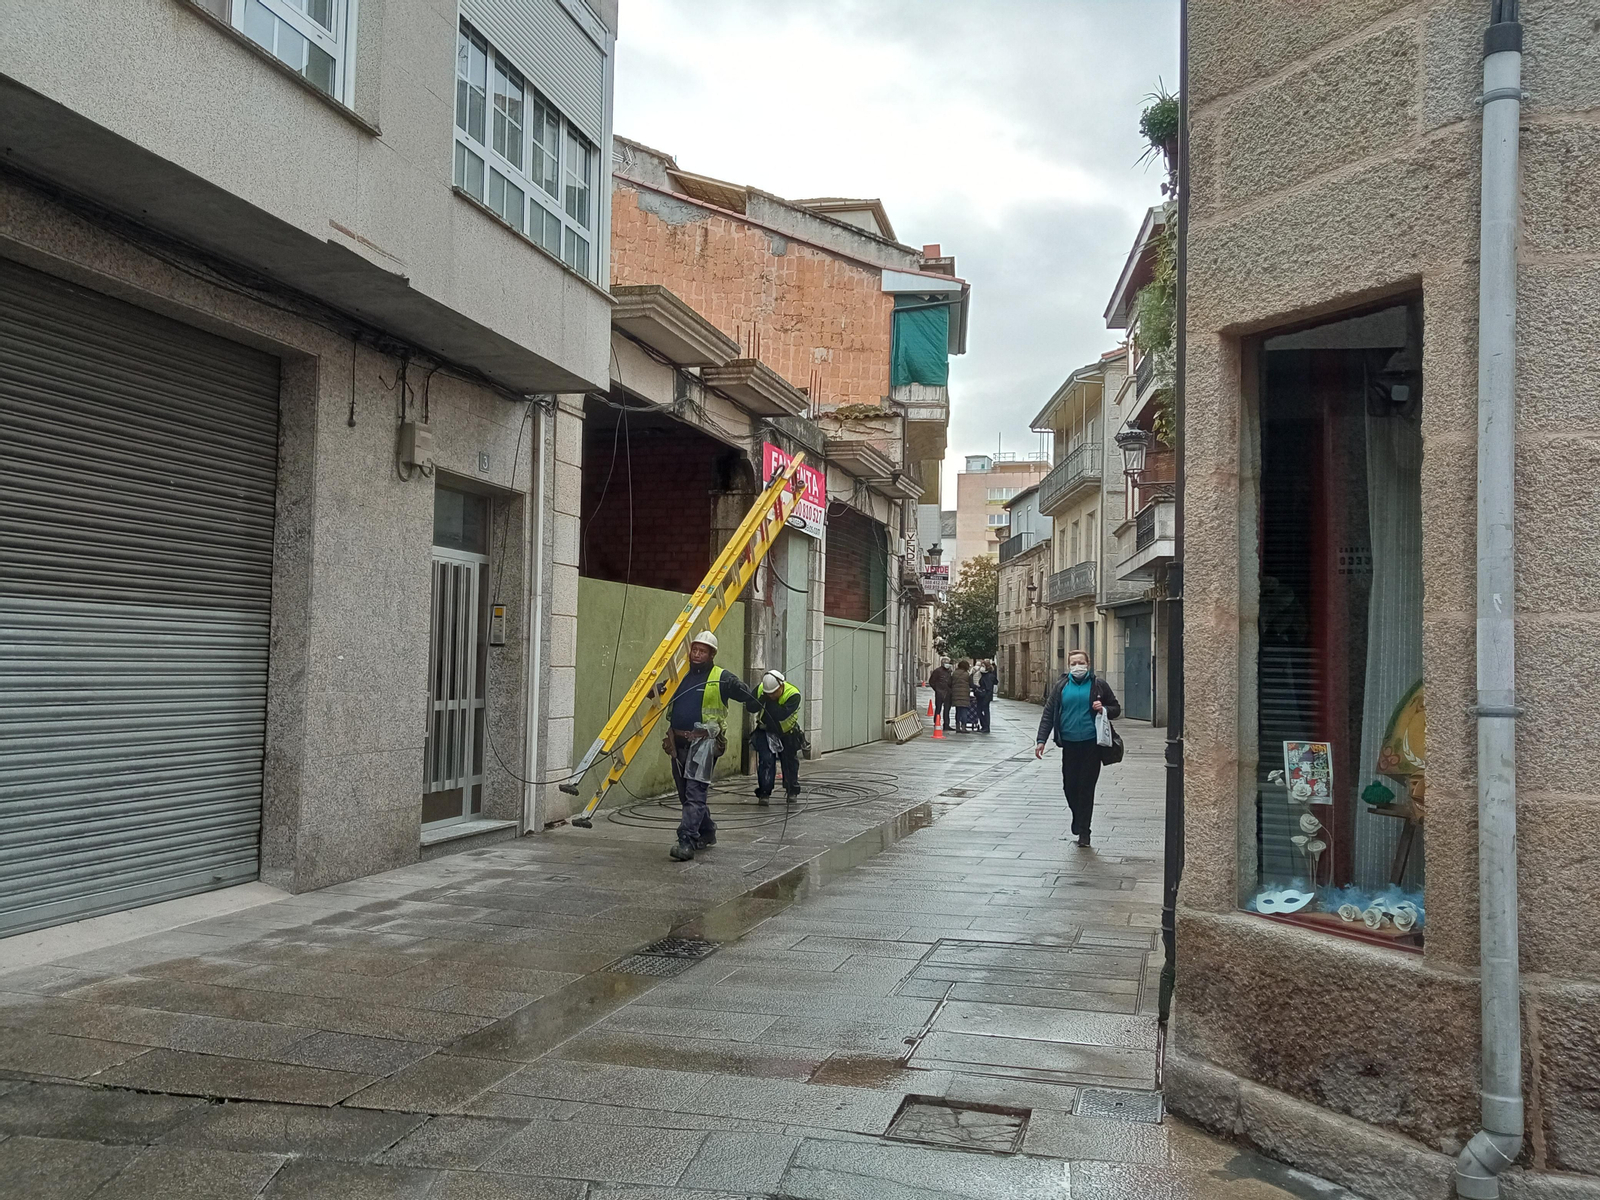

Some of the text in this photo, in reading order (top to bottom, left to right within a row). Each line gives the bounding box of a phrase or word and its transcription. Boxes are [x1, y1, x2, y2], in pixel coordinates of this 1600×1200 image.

[482, 456, 488, 469] 3
[787, 459, 819, 498] NTA
[802, 503, 813, 521] 810
[813, 507, 822, 525] 527
[925, 566, 949, 574] VENDE
